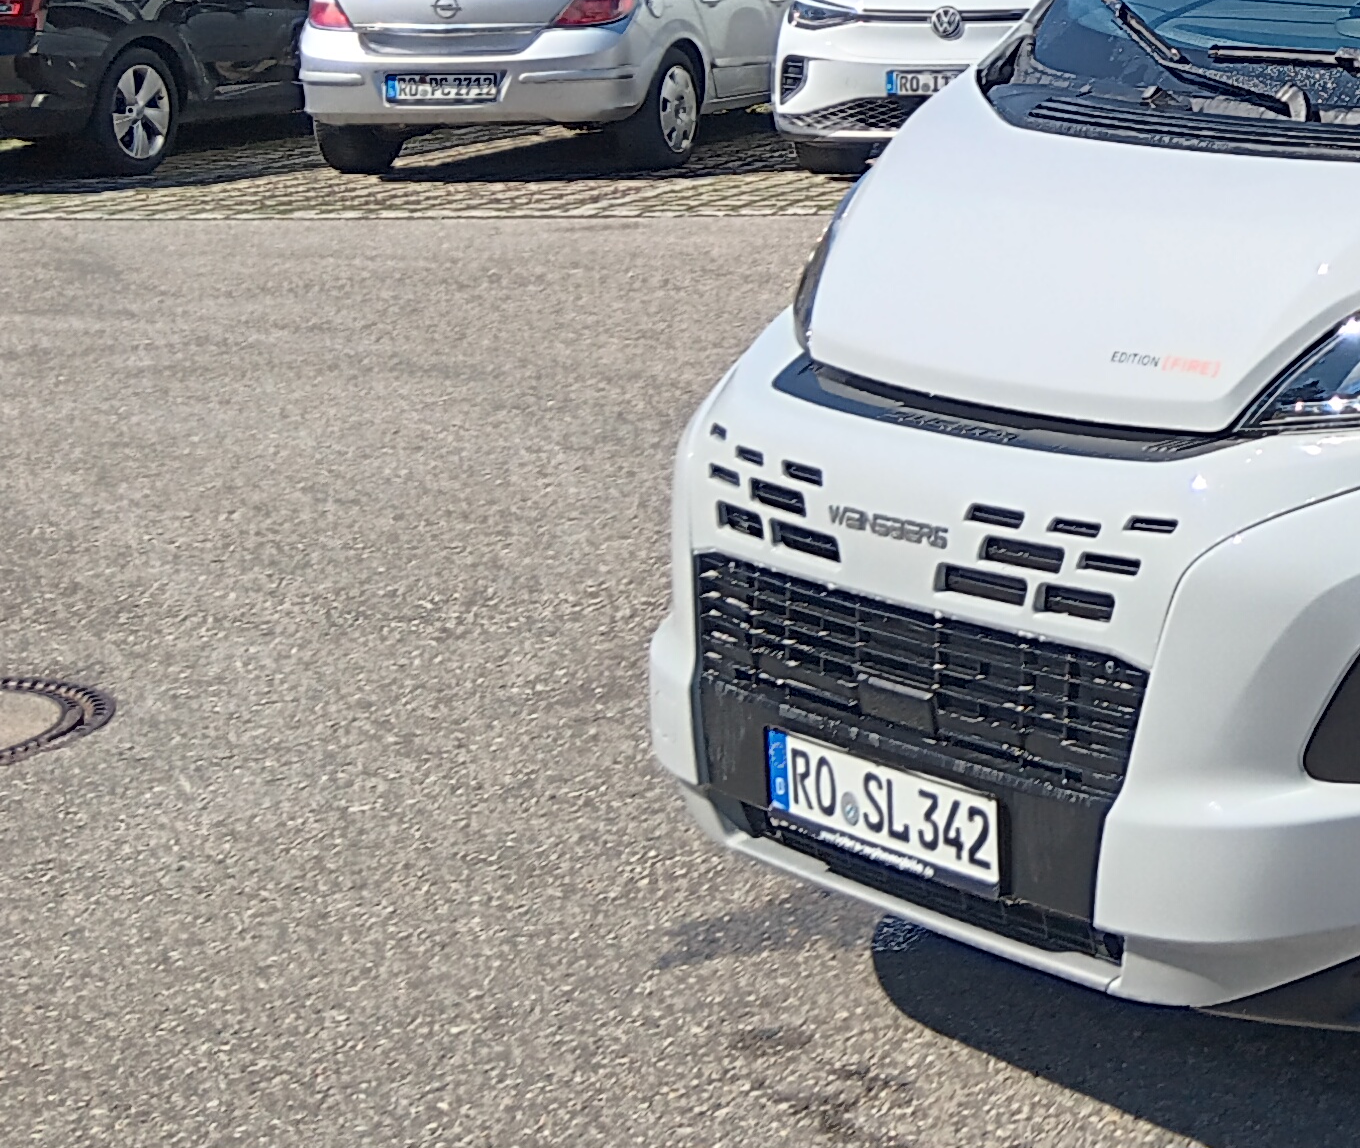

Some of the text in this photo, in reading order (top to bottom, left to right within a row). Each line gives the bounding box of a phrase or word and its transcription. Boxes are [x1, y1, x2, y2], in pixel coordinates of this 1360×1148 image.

[899, 75, 920, 92] RO
[1110, 351, 1161, 368] EDITION
[828, 504, 949, 550] WEINSBERG
[790, 747, 837, 817] RO
[863, 771, 910, 844] SL
[918, 788, 991, 870] 342
